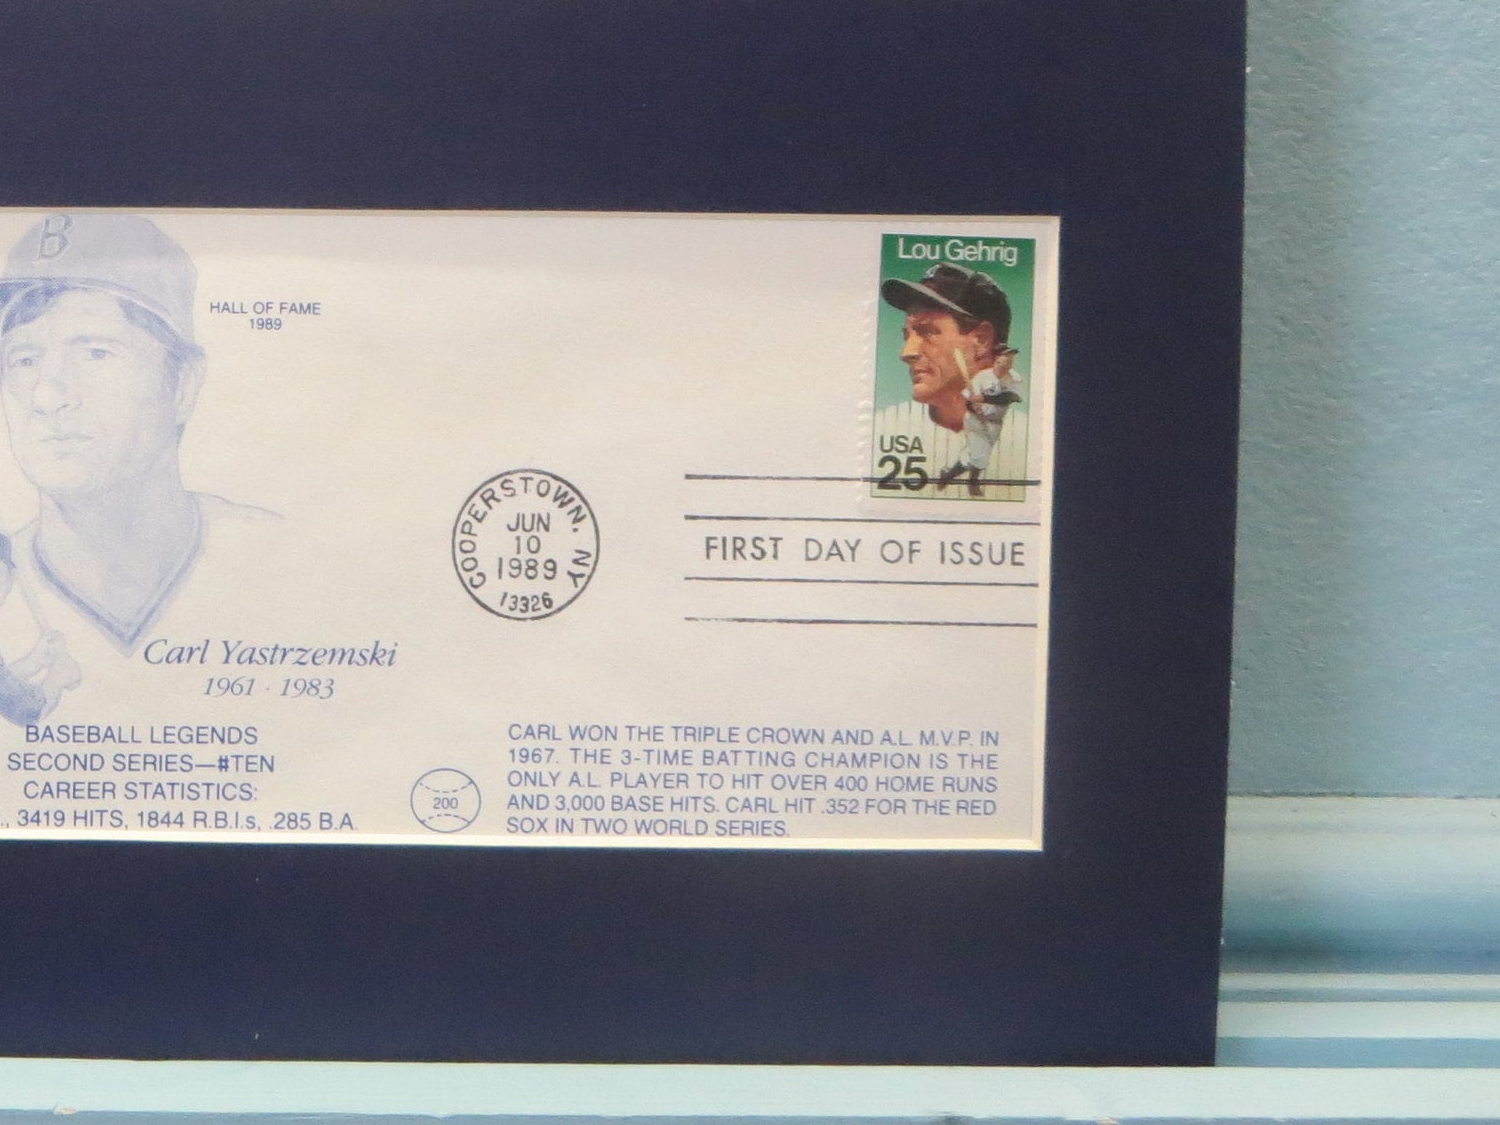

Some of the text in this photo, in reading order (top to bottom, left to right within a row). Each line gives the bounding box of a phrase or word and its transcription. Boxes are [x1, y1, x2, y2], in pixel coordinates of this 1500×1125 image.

[37, 214, 73, 260] B
[899, 238, 1017, 266] Lou Gehrig
[209, 301, 321, 316] HALL OF FAME
[249, 317, 283, 331] 1989
[880, 435, 923, 454] USA
[877, 456, 928, 491] 25
[507, 513, 550, 532] JUN
[516, 536, 541, 555] 10
[705, 535, 1025, 567] FIRST DAY OF ISSUE
[498, 557, 557, 580] 1989
[567, 549, 591, 588] NY
[500, 592, 553, 612] 13326
[143, 638, 399, 667] Carl Yastrzemski
[204, 676, 256, 696] 1961
[279, 677, 335, 700] 1983
[25, 724, 258, 746] BASEBALL LEGENDS
[507, 723, 563, 741] CARL
[568, 724, 618, 742] WON
[624, 724, 665, 743] THE
[670, 725, 741, 744] TRIPLE
[746, 726, 825, 745] CROWN
[830, 729, 874, 746] AND
[980, 730, 1000, 747] IN
[7, 752, 105, 772] SECOND
[569, 747, 613, 765] THE
[620, 748, 694, 766] 3-TIME
[702, 749, 796, 768] BATTING
[804, 751, 921, 770] CHAMPION
[929, 752, 949, 770] IS
[956, 752, 999, 771] THE
[23, 780, 258, 802] CAREER STATISTICS:
[507, 769, 561, 788] ONLY
[610, 771, 690, 790] PLAYER
[696, 772, 725, 791] TO
[731, 772, 765, 790] HIT
[770, 773, 828, 791] OVER
[833, 775, 869, 792] 400
[875, 775, 935, 793] HOME
[942, 776, 998, 794] RUNS
[432, 796, 459, 810] 200
[506, 793, 997, 816] AND 3,000 BASE HITS. CARL HIT .352 FOR THE RED
[17, 808, 66, 828] 3419
[72, 809, 129, 830] HITS,
[137, 810, 185, 829] 1844
[268, 811, 311, 830] .285
[506, 816, 790, 837] SOX IN TWO WORLD SERIES.
